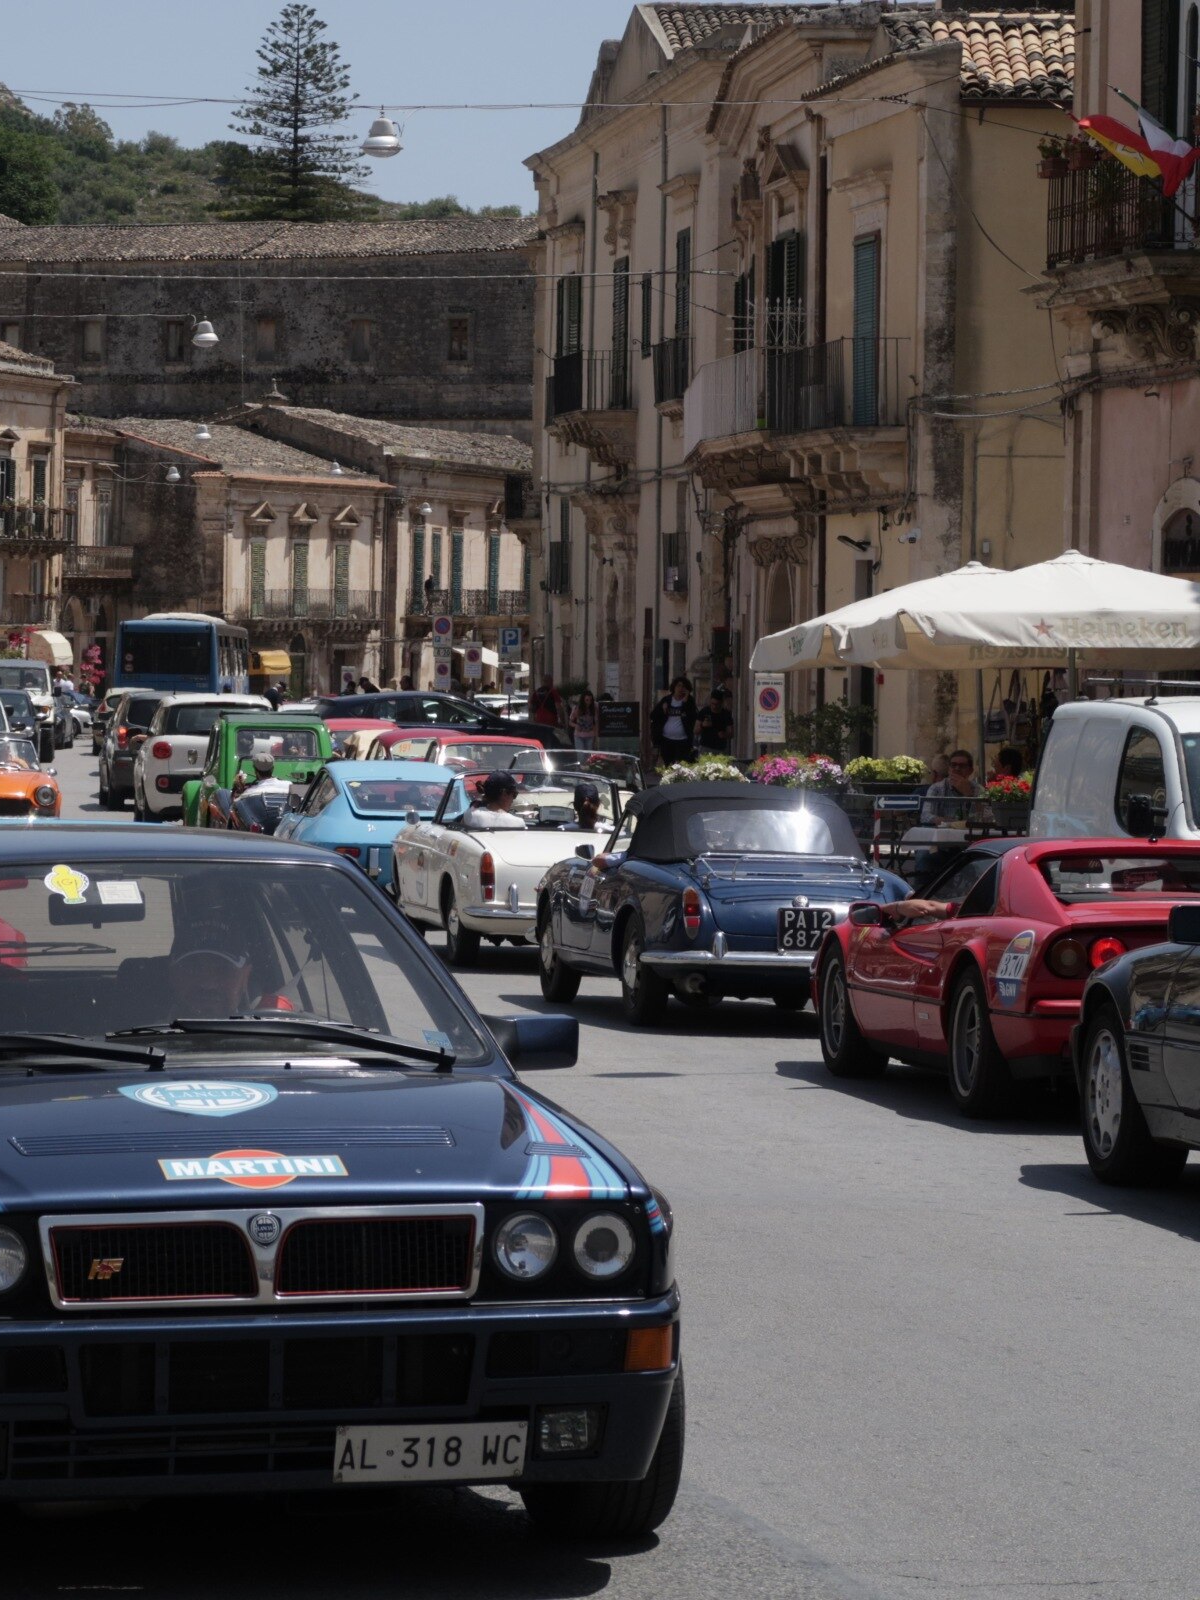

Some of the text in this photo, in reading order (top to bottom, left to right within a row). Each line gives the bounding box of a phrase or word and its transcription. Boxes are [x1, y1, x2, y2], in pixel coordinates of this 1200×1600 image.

[1059, 616, 1189, 639] Heineken
[784, 911, 832, 929] PA 12
[783, 929, 827, 948] 687
[1000, 954, 1025, 977] 370
[168, 1089, 241, 1099] LANCIA
[170, 1158, 338, 1177] MARTINI
[338, 1433, 522, 1470] AL 318 WC
